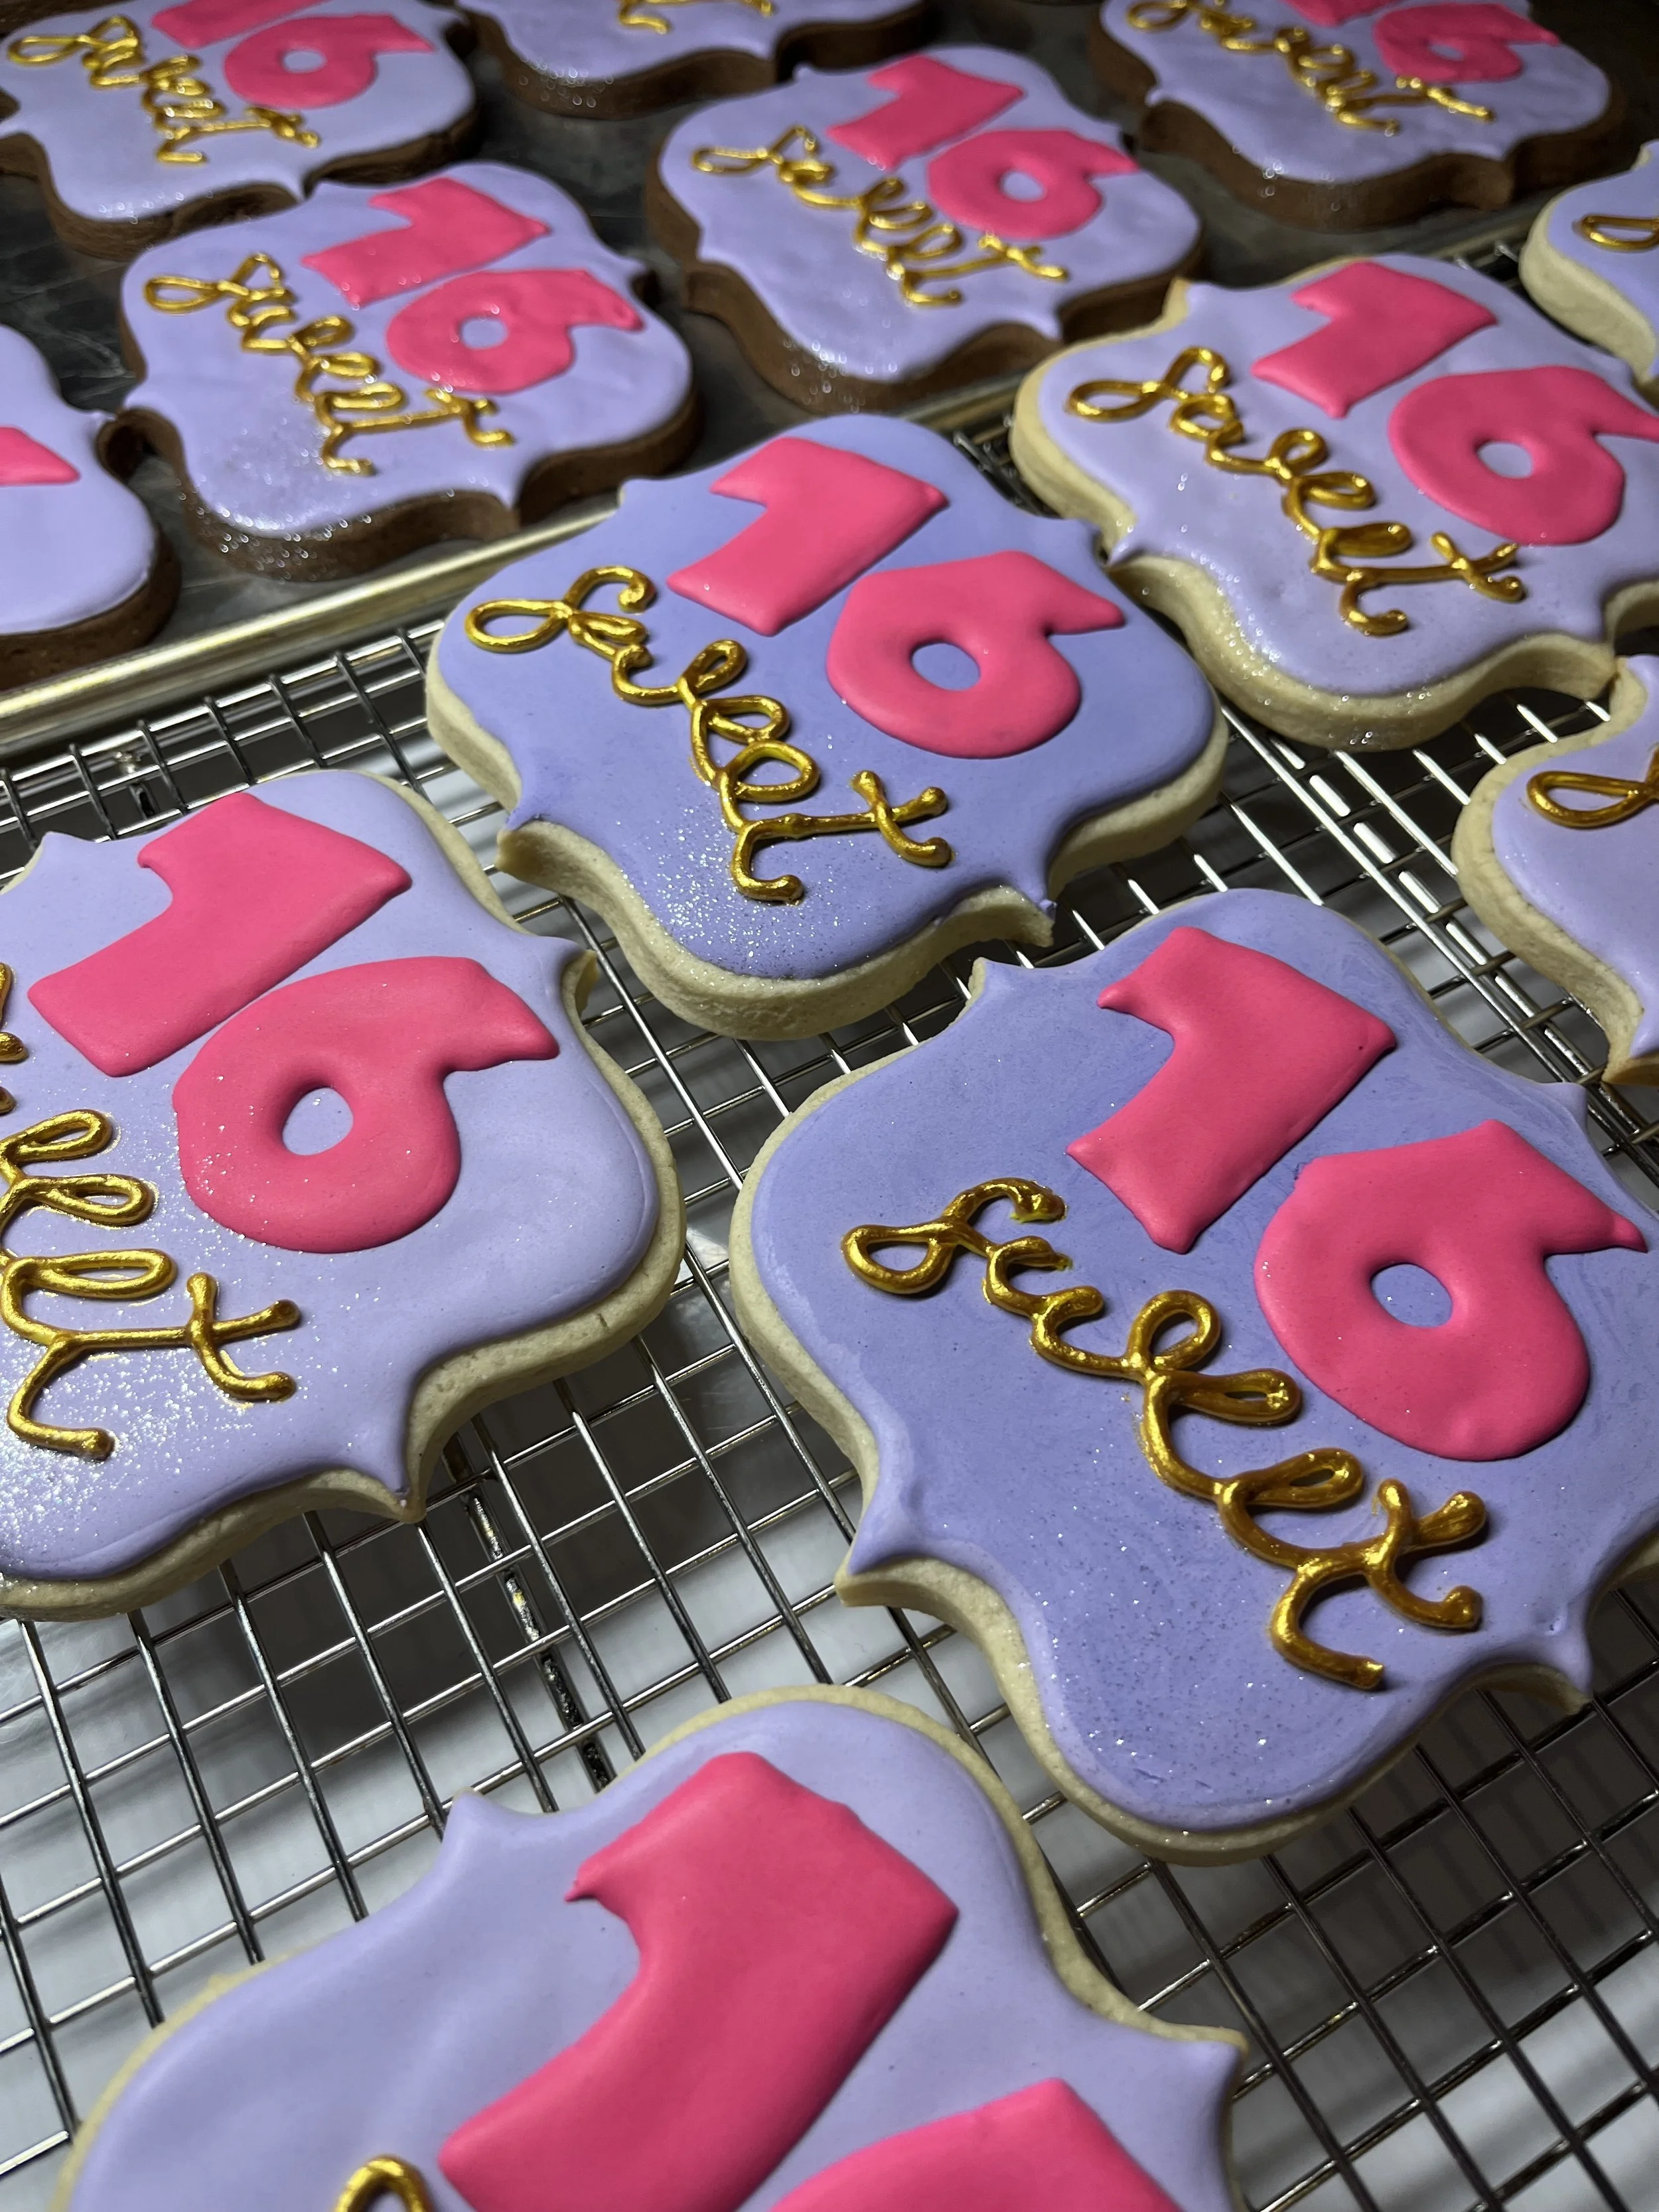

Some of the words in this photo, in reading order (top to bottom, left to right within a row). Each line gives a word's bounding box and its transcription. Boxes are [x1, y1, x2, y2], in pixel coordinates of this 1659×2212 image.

[827, 53, 1141, 239] 16
[1284, 0, 1561, 84] 6
[300, 177, 644, 395] 16
[1250, 261, 1659, 546] 16
[666, 437, 1125, 759] 16
[1065, 346, 1526, 636] Sweet
[465, 565, 953, 903] Sweet
[27, 792, 561, 1254] 16
[1066, 926, 1647, 1461] 16
[841, 1178, 1488, 1690] Sweet
